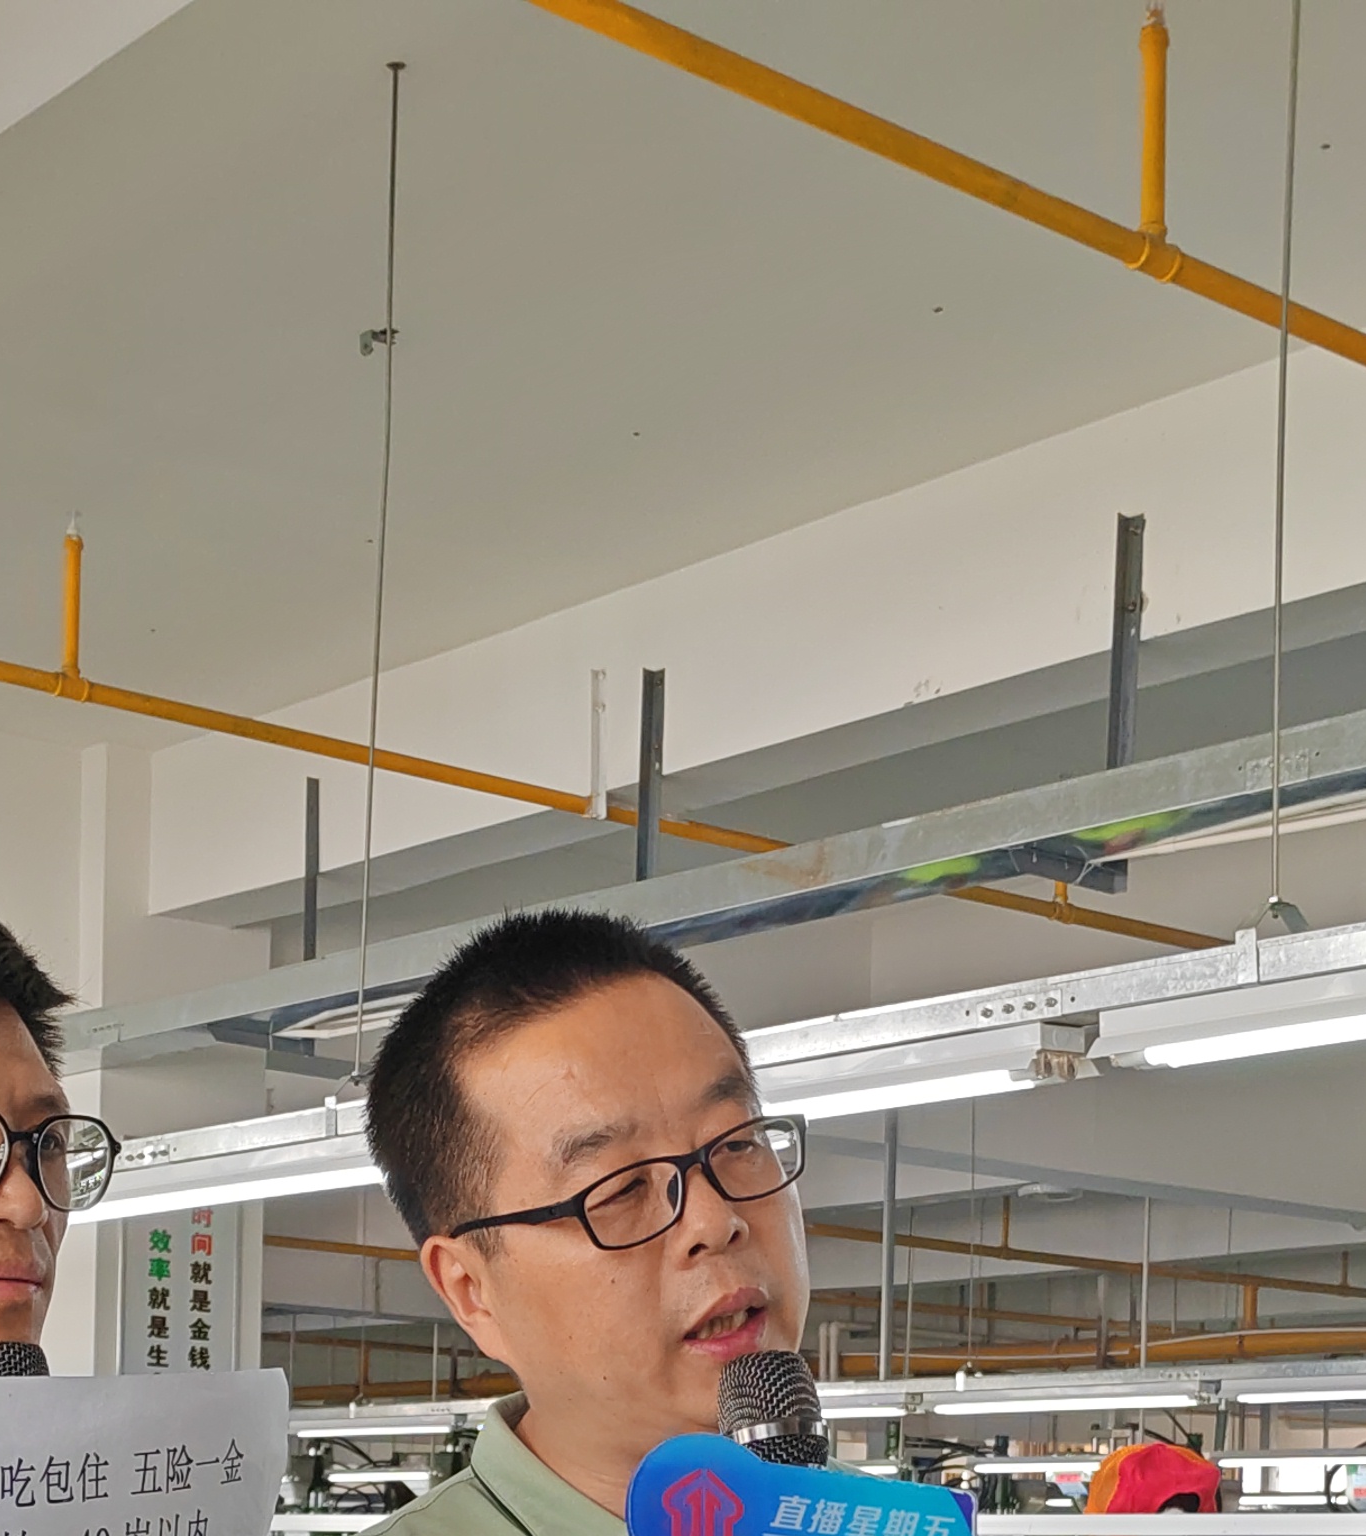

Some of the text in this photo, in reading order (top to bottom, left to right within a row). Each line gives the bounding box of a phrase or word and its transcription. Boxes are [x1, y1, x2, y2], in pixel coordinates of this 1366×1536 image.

[147, 1229, 172, 1375] 效率就是生
[130, 1438, 246, 1496] 五险一金
